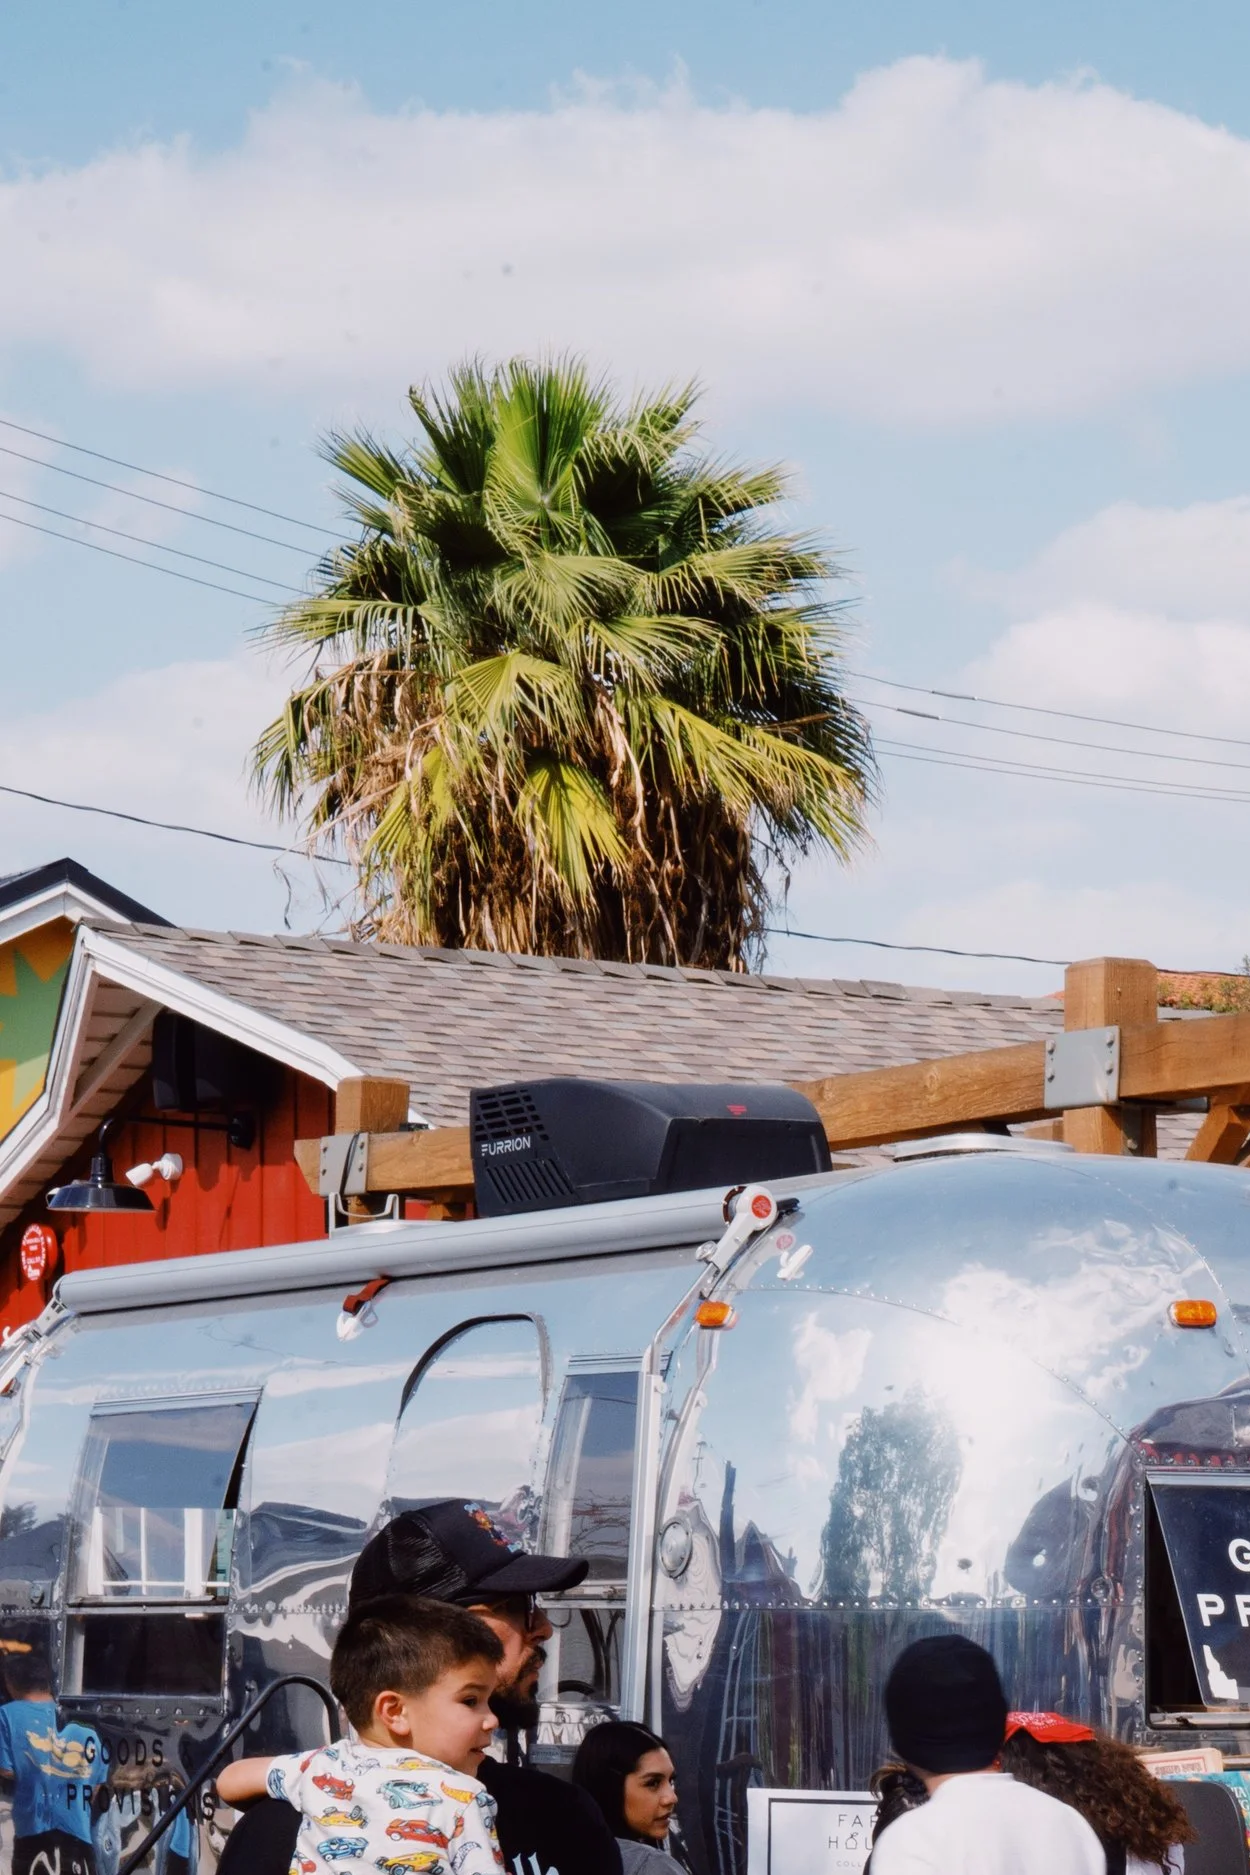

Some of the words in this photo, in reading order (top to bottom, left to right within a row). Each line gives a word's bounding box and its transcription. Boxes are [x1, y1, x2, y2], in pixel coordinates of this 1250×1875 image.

[481, 1135, 531, 1157] FURRION
[84, 1736, 164, 1767] GOODS
[65, 1784, 217, 1822] PROVISIS
[838, 1814, 878, 1828] FAR
